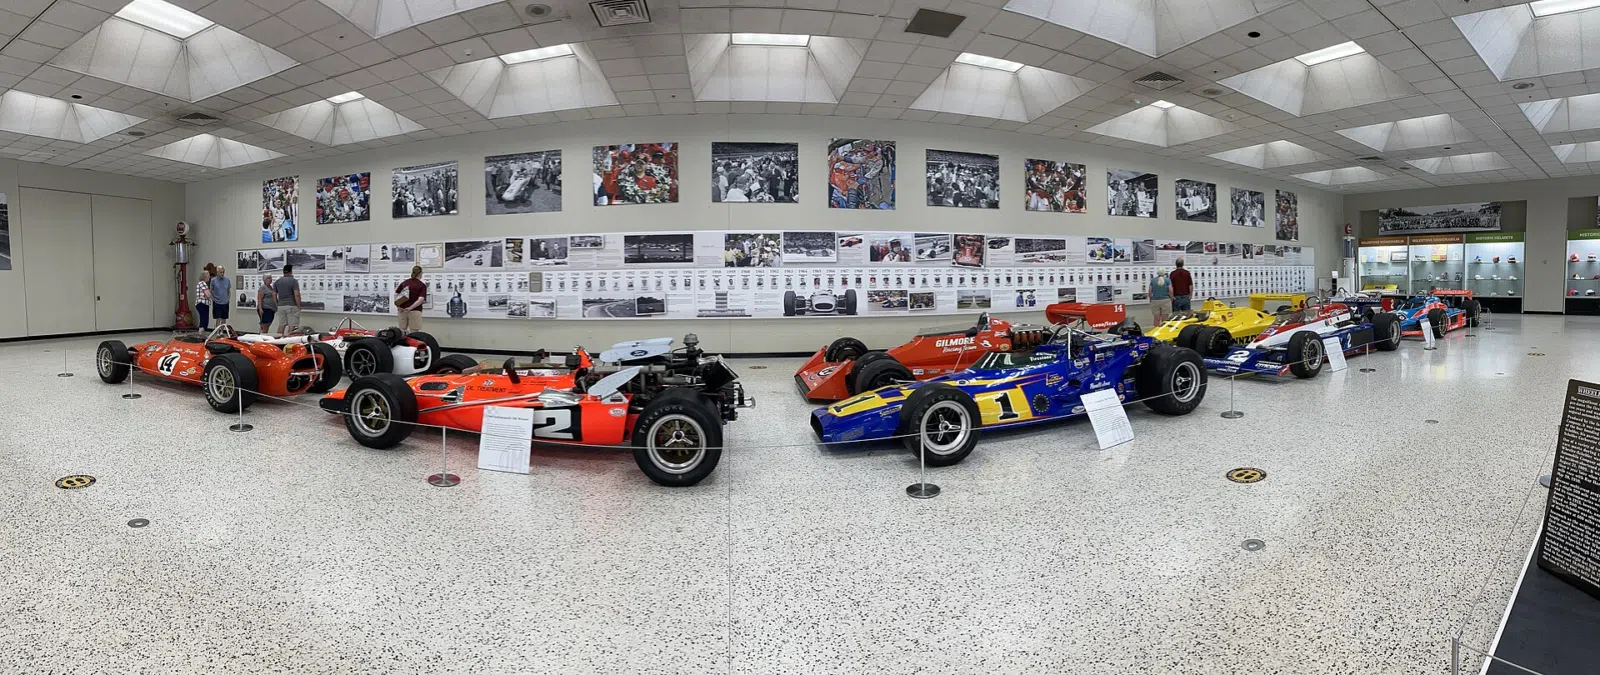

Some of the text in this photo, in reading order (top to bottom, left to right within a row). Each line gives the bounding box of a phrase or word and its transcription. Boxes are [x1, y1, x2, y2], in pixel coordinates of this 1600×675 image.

[936, 337, 975, 347] GILMORE
[160, 355, 179, 372] 14
[1227, 350, 1250, 363] 2
[991, 390, 1019, 420] 1
[534, 409, 573, 439] 2
